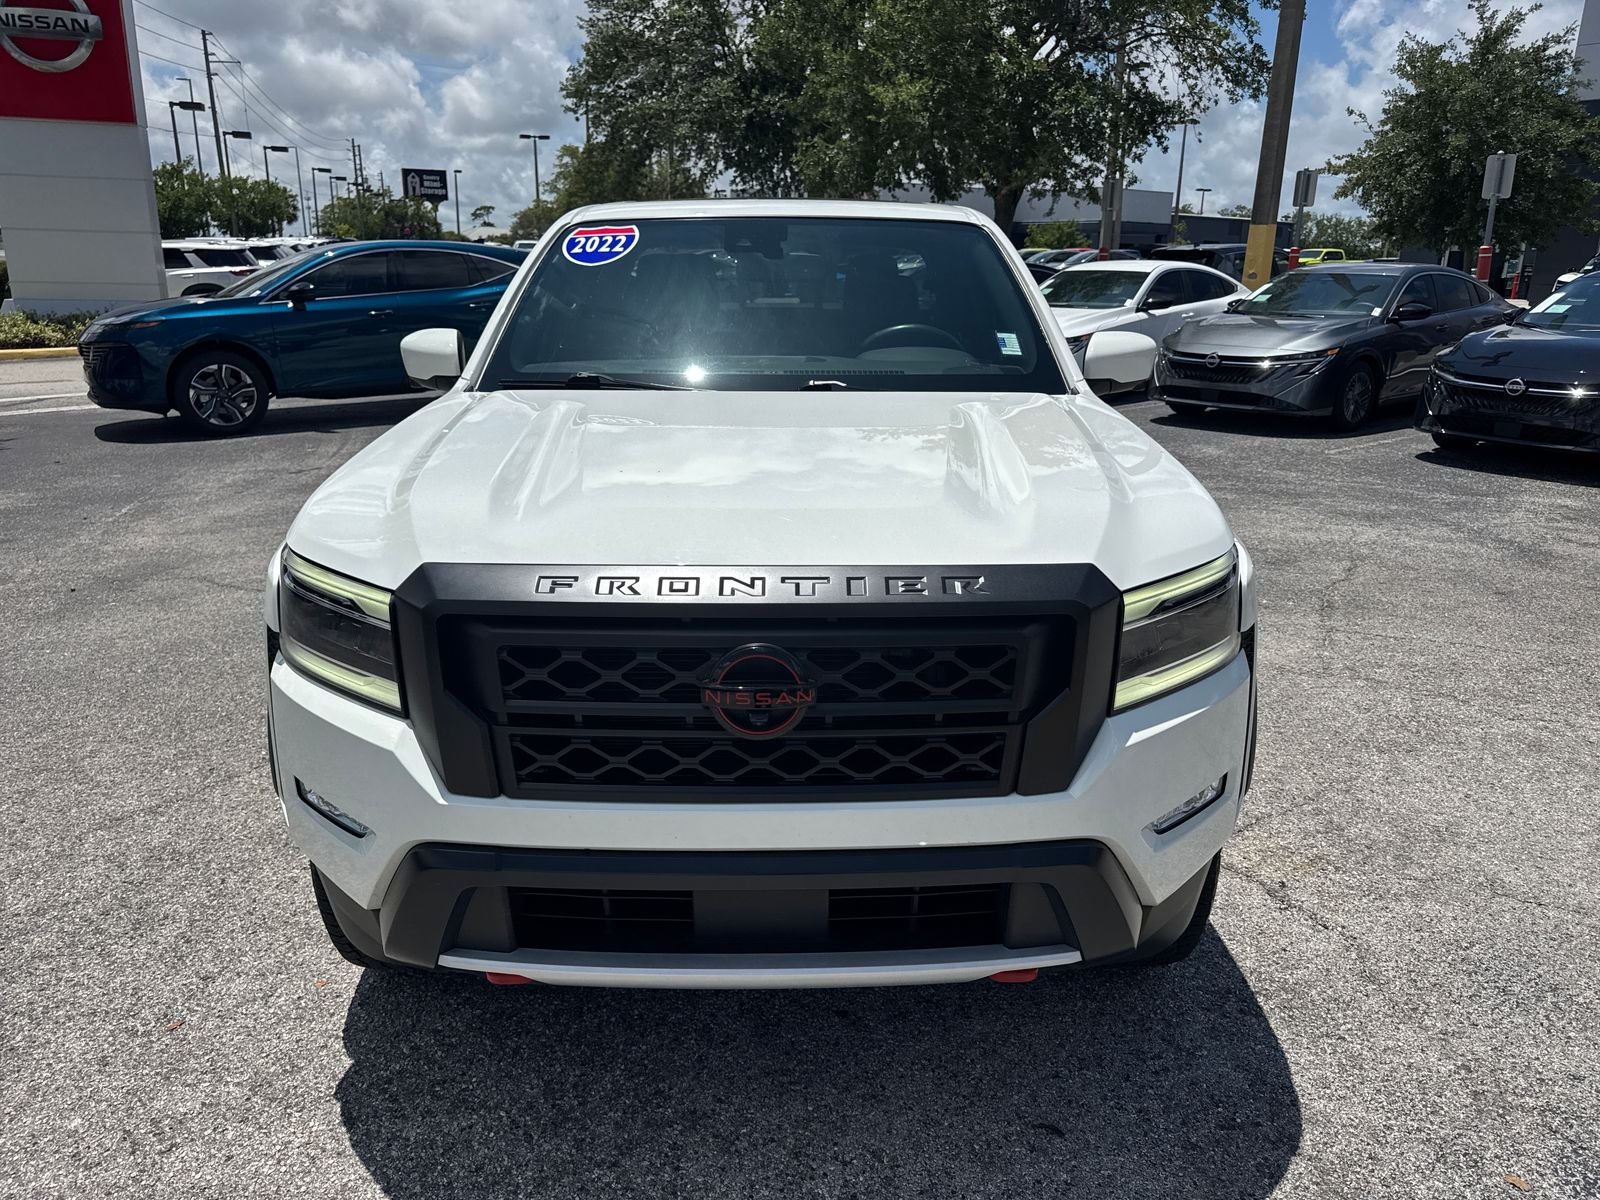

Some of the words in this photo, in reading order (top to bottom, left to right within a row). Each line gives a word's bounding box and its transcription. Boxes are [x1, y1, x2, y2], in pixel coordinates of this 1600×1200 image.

[0, 12, 90, 32] NISSAN
[570, 235, 627, 253] 2022
[534, 575, 991, 597] FRONTIER
[704, 689, 814, 705] NISSAN
